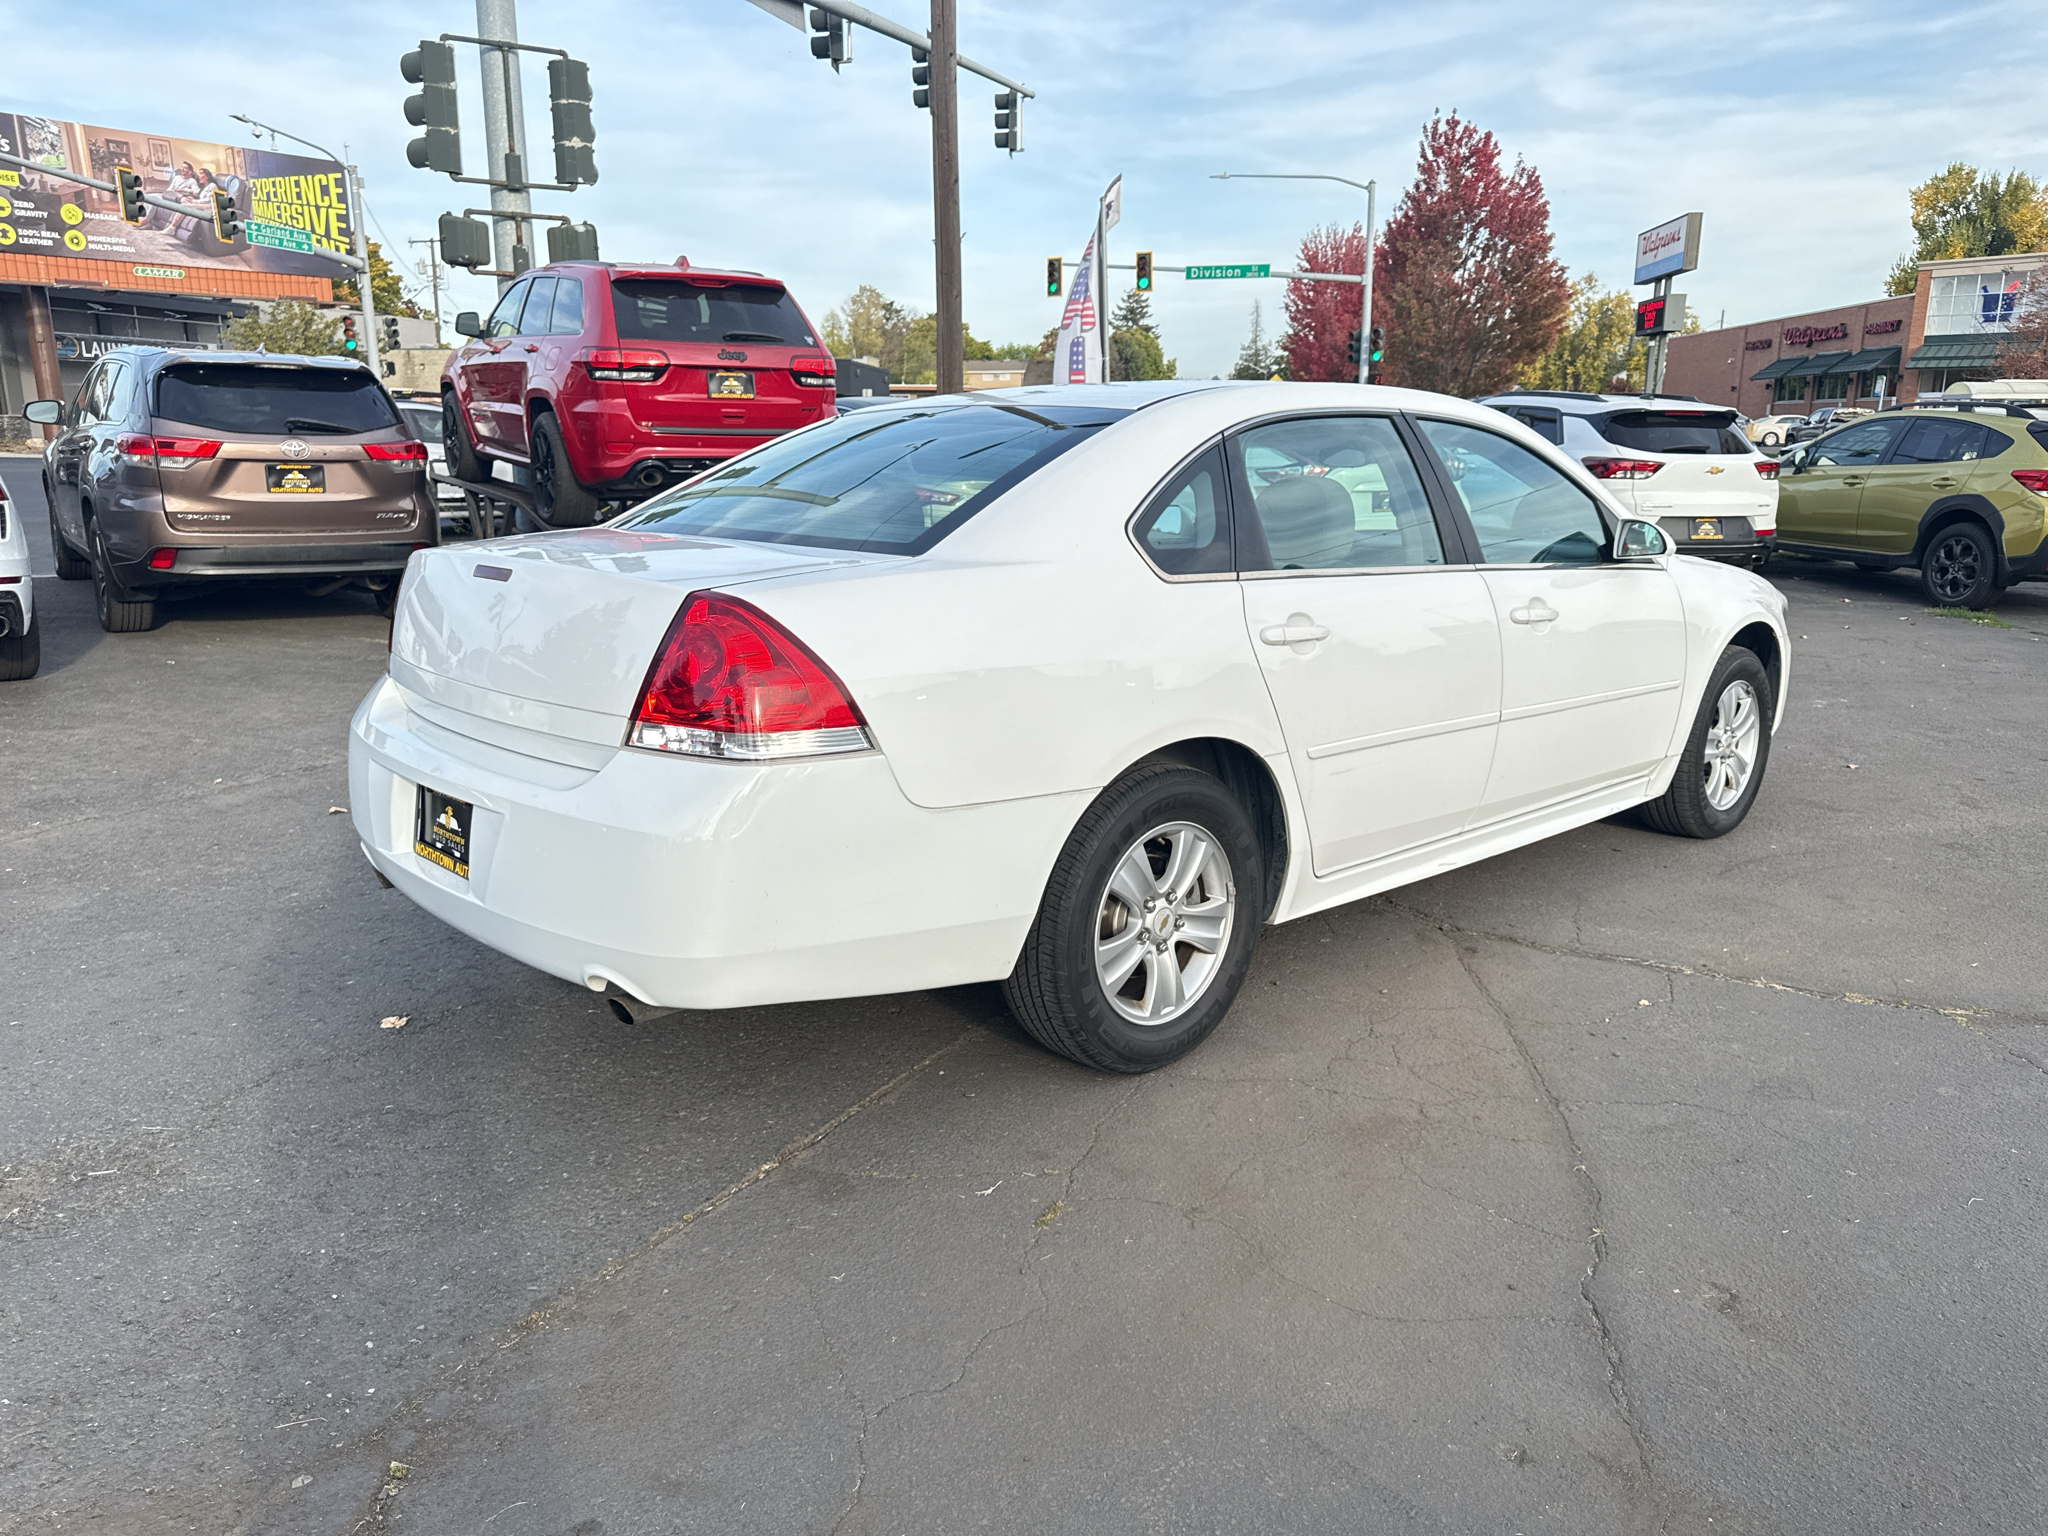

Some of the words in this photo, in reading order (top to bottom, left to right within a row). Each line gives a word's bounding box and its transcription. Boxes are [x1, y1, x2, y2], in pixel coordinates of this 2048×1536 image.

[250, 173, 346, 209] EXPERIENCE
[14, 200, 35, 209] ZERO
[15, 210, 48, 219] GRAVITY
[84, 212, 119, 221] MASSAGE
[252, 200, 350, 243] IMMERSIVE
[18, 228, 40, 237] 100%
[41, 230, 61, 239] REAL
[87, 235, 127, 245] IMMERSIVE
[260, 225, 290, 238] Garland
[293, 231, 309, 241] Ave.
[19, 237, 54, 246] LEATHER
[88, 243, 136, 253] MULTI-MEDIA
[252, 233, 280, 246] Empire
[283, 238, 299, 249] Ave.
[1642, 226, 1682, 258] Walgreens
[138, 267, 180, 278] LAMAR
[1190, 266, 1242, 278] Division
[1783, 324, 1846, 347] Walgreens
[1865, 320, 1901, 335] PHARMACY
[717, 348, 748, 363] Jeep
[433, 825, 465, 845] NORTHTOWN
[432, 833, 446, 844] AUTO
[447, 840, 465, 853] SALES
[415, 841, 454, 871] NORTHTOWN
[455, 862, 469, 878] AUT
